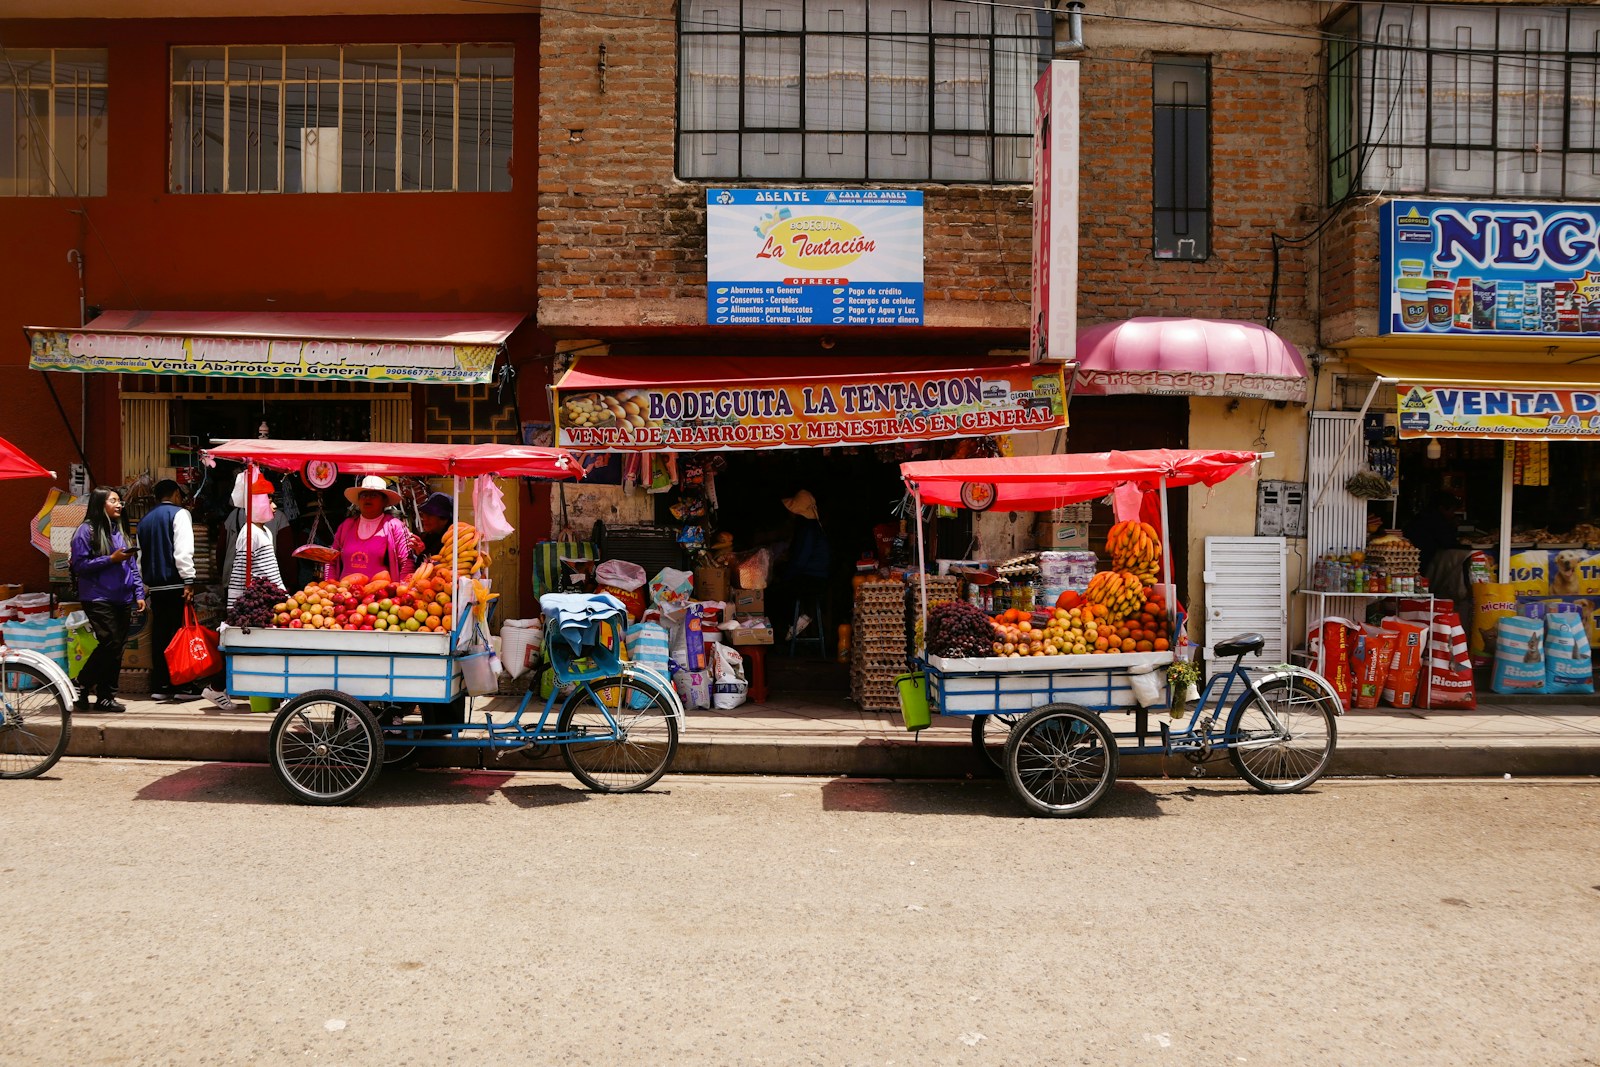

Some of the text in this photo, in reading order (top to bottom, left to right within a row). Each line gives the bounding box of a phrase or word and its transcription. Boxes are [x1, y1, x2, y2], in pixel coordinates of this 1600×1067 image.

[1057, 69, 1075, 151] MAKE
[755, 191, 810, 202] AGENTE
[863, 191, 878, 199] LOS
[880, 191, 907, 199] ANDES
[790, 220, 841, 231] BODEGUITA
[1435, 213, 1600, 265] NEG
[756, 233, 876, 259] La Tentación
[730, 286, 763, 294] Abarrotes
[776, 286, 803, 294] General
[848, 288, 865, 296] Pago
[878, 287, 902, 295] crédito
[1055, 224, 1073, 351] ARTIST
[730, 295, 764, 304] Conservas
[770, 295, 799, 304] Cereales
[848, 297, 879, 306] Recargas
[730, 305, 813, 314] Alimentos para Mascotas
[848, 307, 865, 315] Pago
[867, 306, 876, 314] de
[878, 307, 896, 315] Agua
[904, 306, 916, 314] Luz
[730, 315, 760, 323] Gaseosas
[765, 315, 791, 323] Cerveza
[796, 315, 812, 323] Licor
[151, 360, 368, 376] Venta Abarrotes en General
[1076, 370, 1215, 391] Variedades
[648, 376, 983, 420] BODEGUITA LA TENTACION
[1010, 390, 1035, 401] GLORIA
[1435, 390, 1600, 415] VENTA D
[566, 406, 1054, 444] VENTA DE ABARROTES Y MENESTRAS EN GENERAL
[1551, 415, 1581, 428] LA
[1434, 424, 1491, 433] Productos
[1494, 424, 1534, 434] lácteos
[1536, 425, 1592, 434] abarrotes
[1431, 674, 1473, 688] Ricocan
